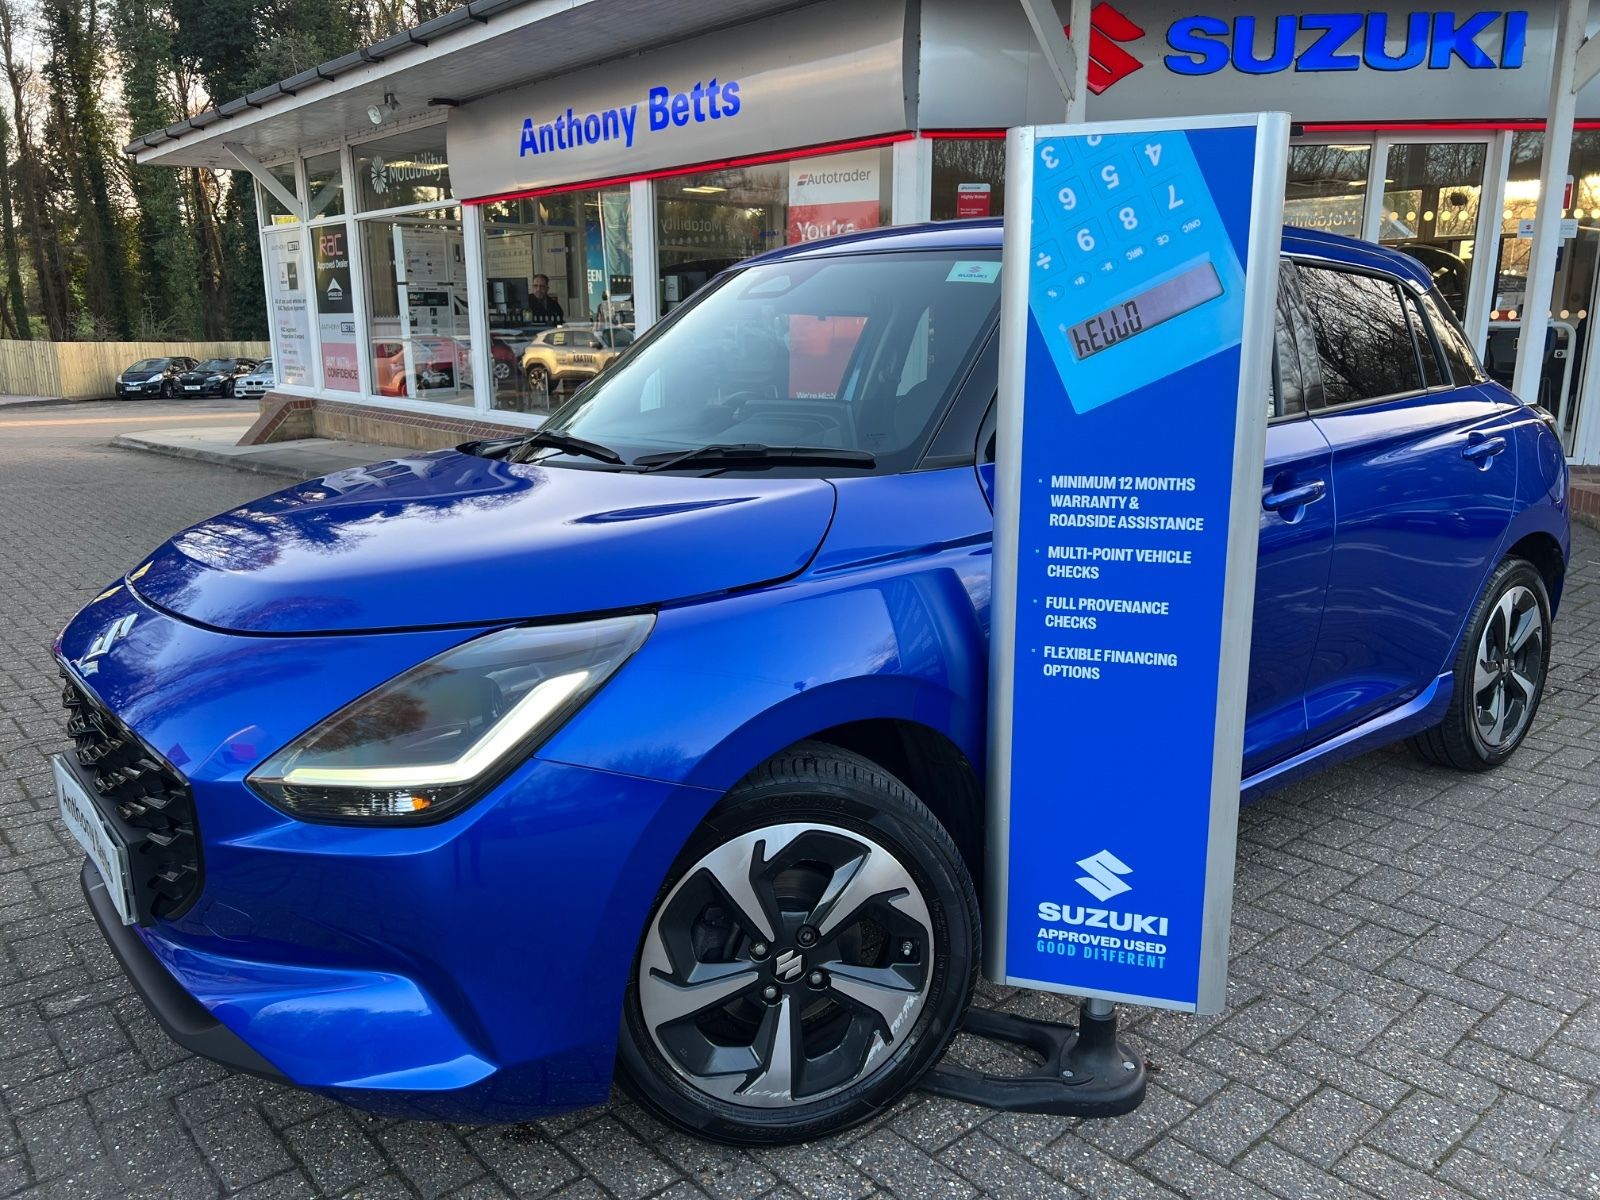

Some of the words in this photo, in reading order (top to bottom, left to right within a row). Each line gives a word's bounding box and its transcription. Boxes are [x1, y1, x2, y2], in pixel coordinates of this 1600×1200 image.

[1164, 10, 1529, 75] SUZUKI
[519, 105, 637, 157] Anthony
[649, 78, 741, 131] Betts
[1144, 143, 1163, 167] 4
[389, 152, 443, 183] Motability
[807, 169, 872, 186] Autotrader
[1100, 164, 1120, 190] 5
[1167, 184, 1185, 210] 7
[1119, 206, 1138, 230] 8
[317, 260, 335, 271] Approved
[327, 368, 358, 379] CONFIDENCE
[1051, 475, 1116, 490] MINIMUM
[1118, 476, 1133, 490] 12
[1134, 477, 1196, 492] MONTHS
[1050, 494, 1127, 509] WARRANTY
[1128, 496, 1140, 510] &
[1049, 514, 1116, 529] ROADSIDE
[1117, 516, 1204, 531] ASSISTANCE
[1047, 546, 1133, 562] MULTI-POINT
[1135, 549, 1192, 564] VEHICLE
[1047, 565, 1100, 580] CHECKS
[1045, 596, 1076, 611] FULL
[1078, 598, 1169, 615] PROVENANCE
[1045, 614, 1097, 630] CHECKS
[1044, 646, 1102, 662] FLEXIBLE
[1103, 649, 1178, 667] FINANCING
[1043, 664, 1101, 680] OPTIONS
[62, 784, 99, 852] Anthony
[1037, 901, 1169, 937] SUZUKI
[1037, 927, 1121, 949] APPROVED
[1123, 939, 1167, 955] USED
[1036, 940, 1076, 957] GOOD
[1083, 946, 1166, 969] DIFFERENT
